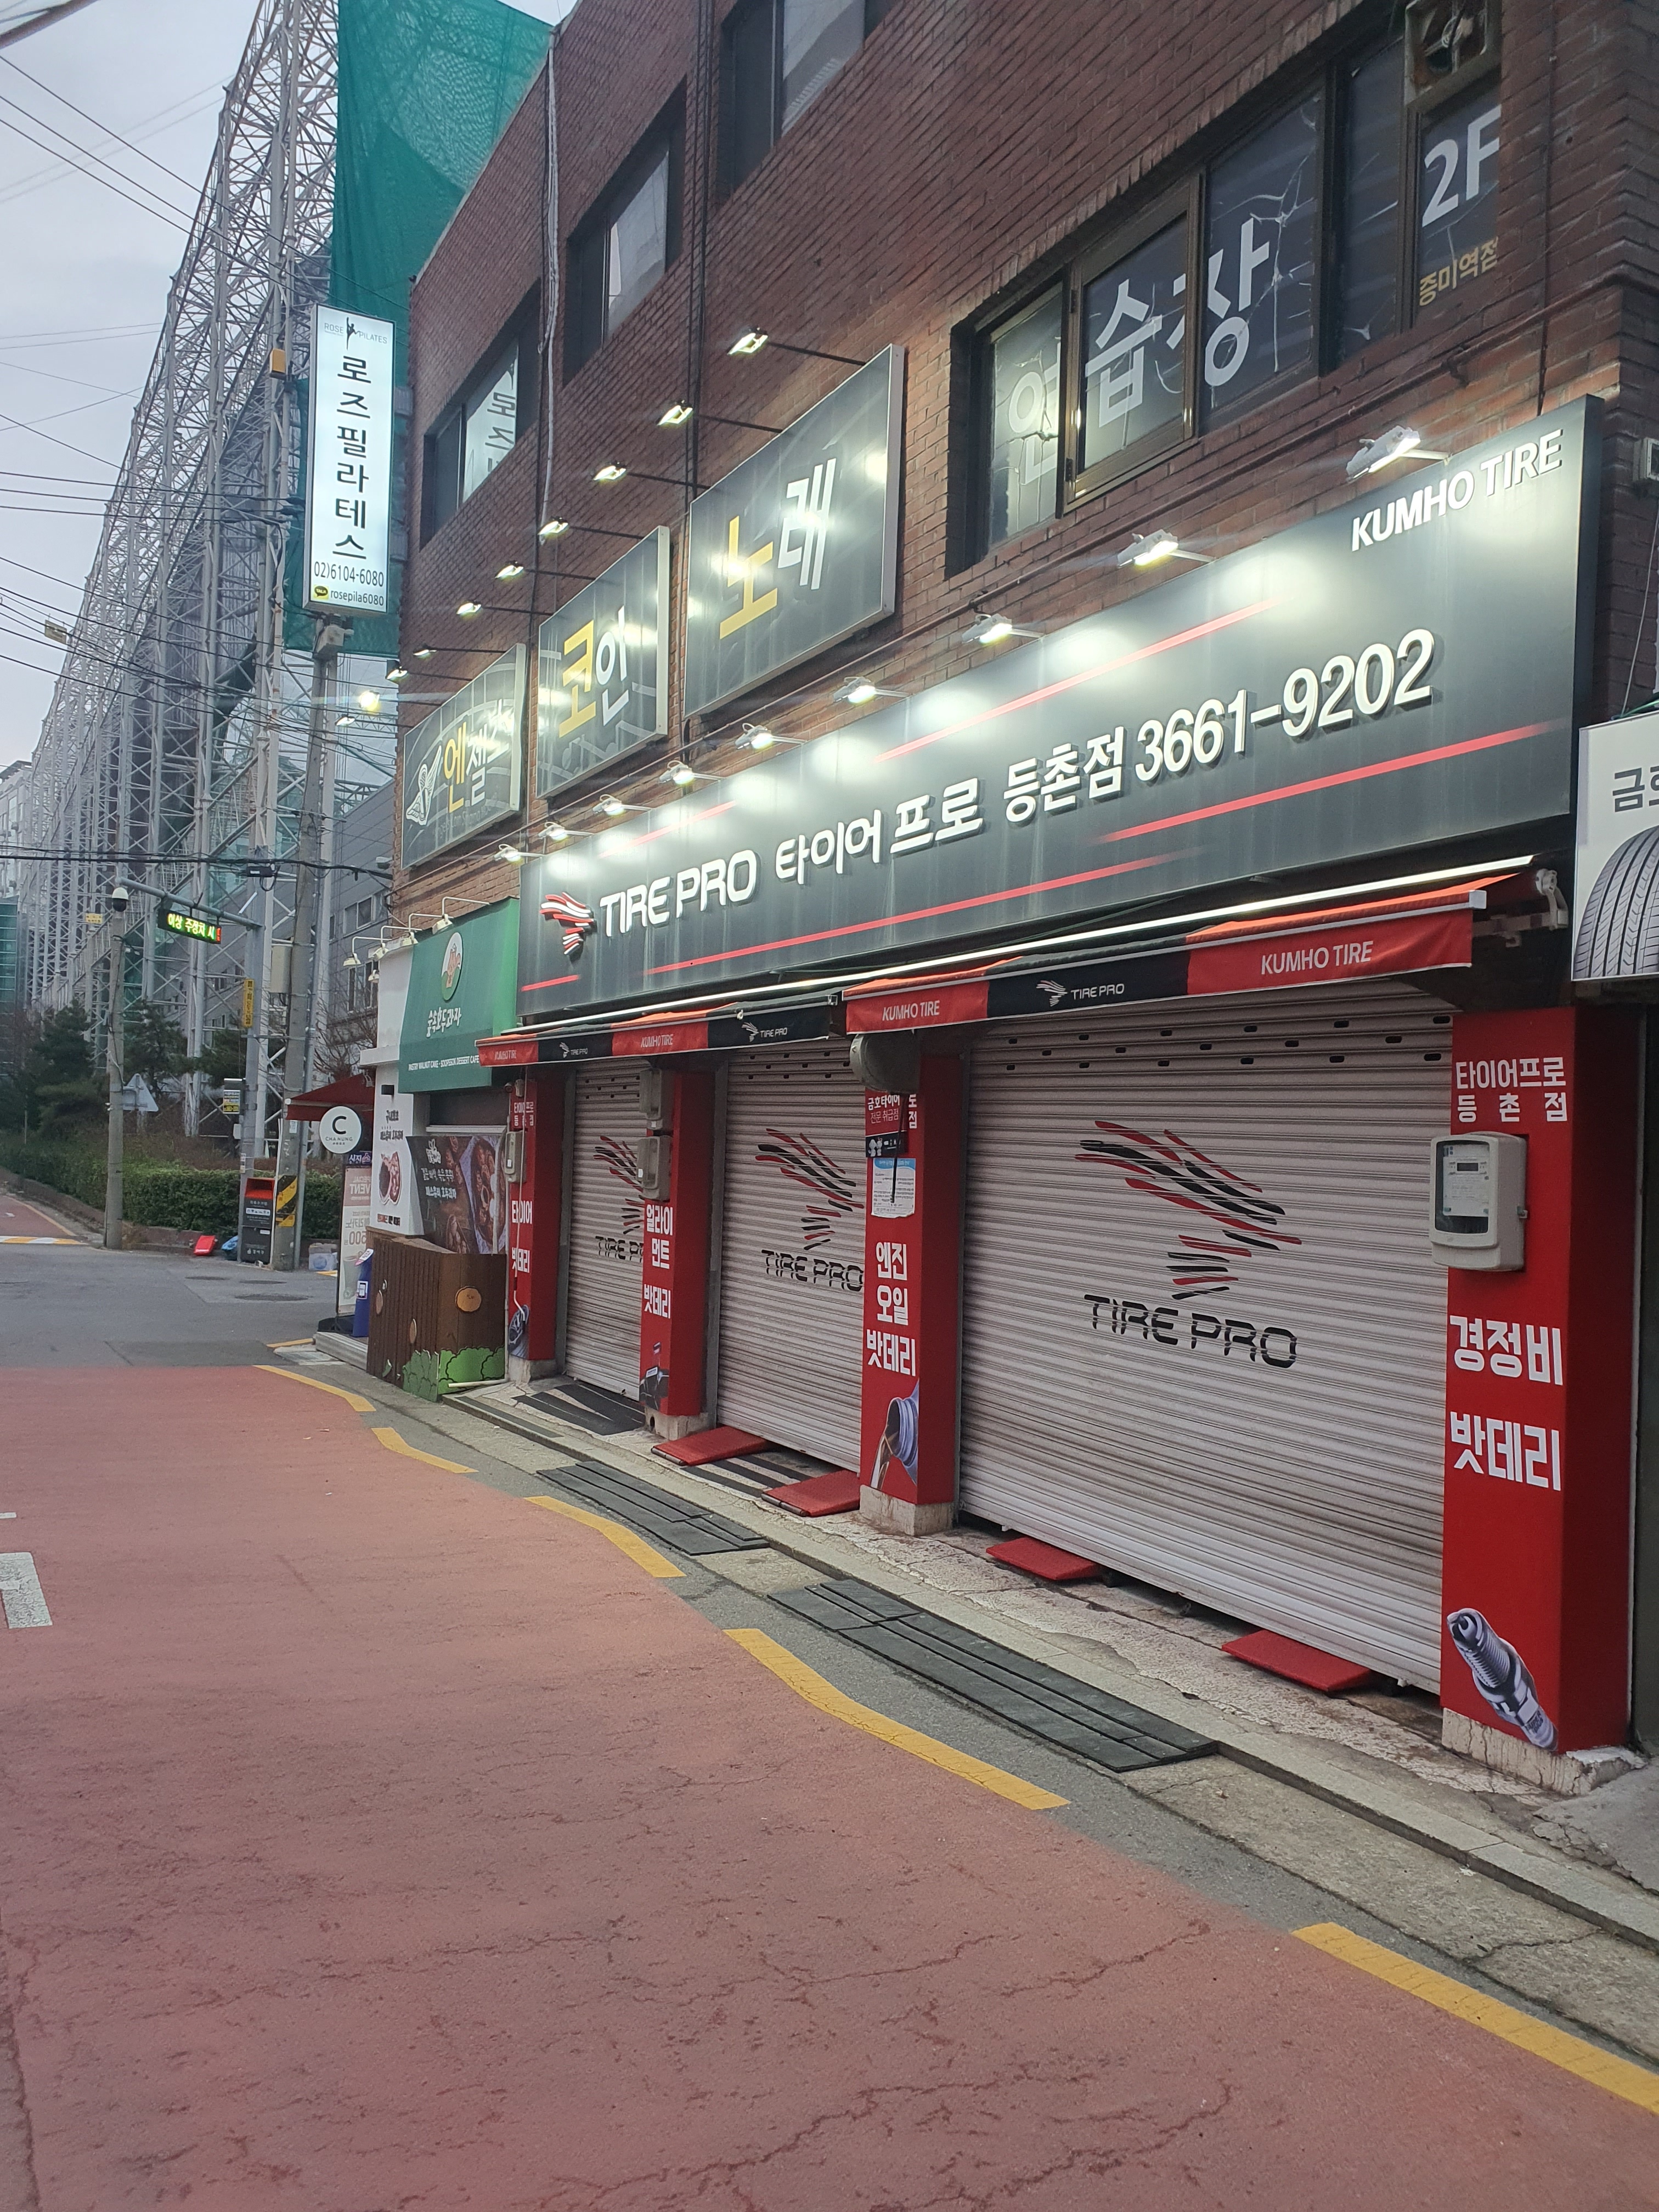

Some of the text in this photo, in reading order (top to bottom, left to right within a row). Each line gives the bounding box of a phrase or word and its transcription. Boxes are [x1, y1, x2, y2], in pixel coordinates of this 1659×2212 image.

[1422, 104, 1501, 227] 2F
[324, 323, 344, 334] ROSE
[359, 331, 387, 344] PILATES
[333, 356, 371, 560] 로즈필라테스
[1352, 428, 1564, 552] KUMHO TIRE
[719, 459, 836, 640] 노래
[314, 561, 384, 587] 02)6104-6080
[331, 590, 384, 606] rosepila6080
[558, 605, 629, 737] 코인
[600, 628, 1435, 937] TIRE PRO 타이어 프로 등촌점 3661-9202
[168, 913, 183, 929] 이상
[185, 918, 205, 936] 주정차
[207, 926, 215, 940] 시
[1261, 940, 1374, 975] KUMHO TIRE
[1071, 983, 1125, 1000] TIRE PRO
[883, 1000, 940, 1021] KUMHO TIRE
[661, 1034, 674, 1045] TIRE
[775, 1028, 788, 1036] PRO
[470, 1055, 479, 1063] CAFE
[1455, 1057, 1567, 1090] 타이어프로
[867, 1094, 900, 1111] 금호타이어
[871, 1108, 899, 1124] 전문 취급점
[511, 1200, 533, 1224] 타이어
[646, 1204, 673, 1235] 얼라이
[652, 1238, 670, 1269] 먼트
[761, 1249, 864, 1292] TIRE PRO
[876, 1242, 907, 1281] 엔진
[644, 1284, 671, 1319] 밧데리
[877, 1285, 909, 1325] 오일
[1084, 1294, 1297, 1369] TIRE PRO
[867, 1329, 916, 1377] 밧데리
[1450, 1315, 1563, 1386] 경정비
[1451, 1411, 1561, 1492] 밧데리
